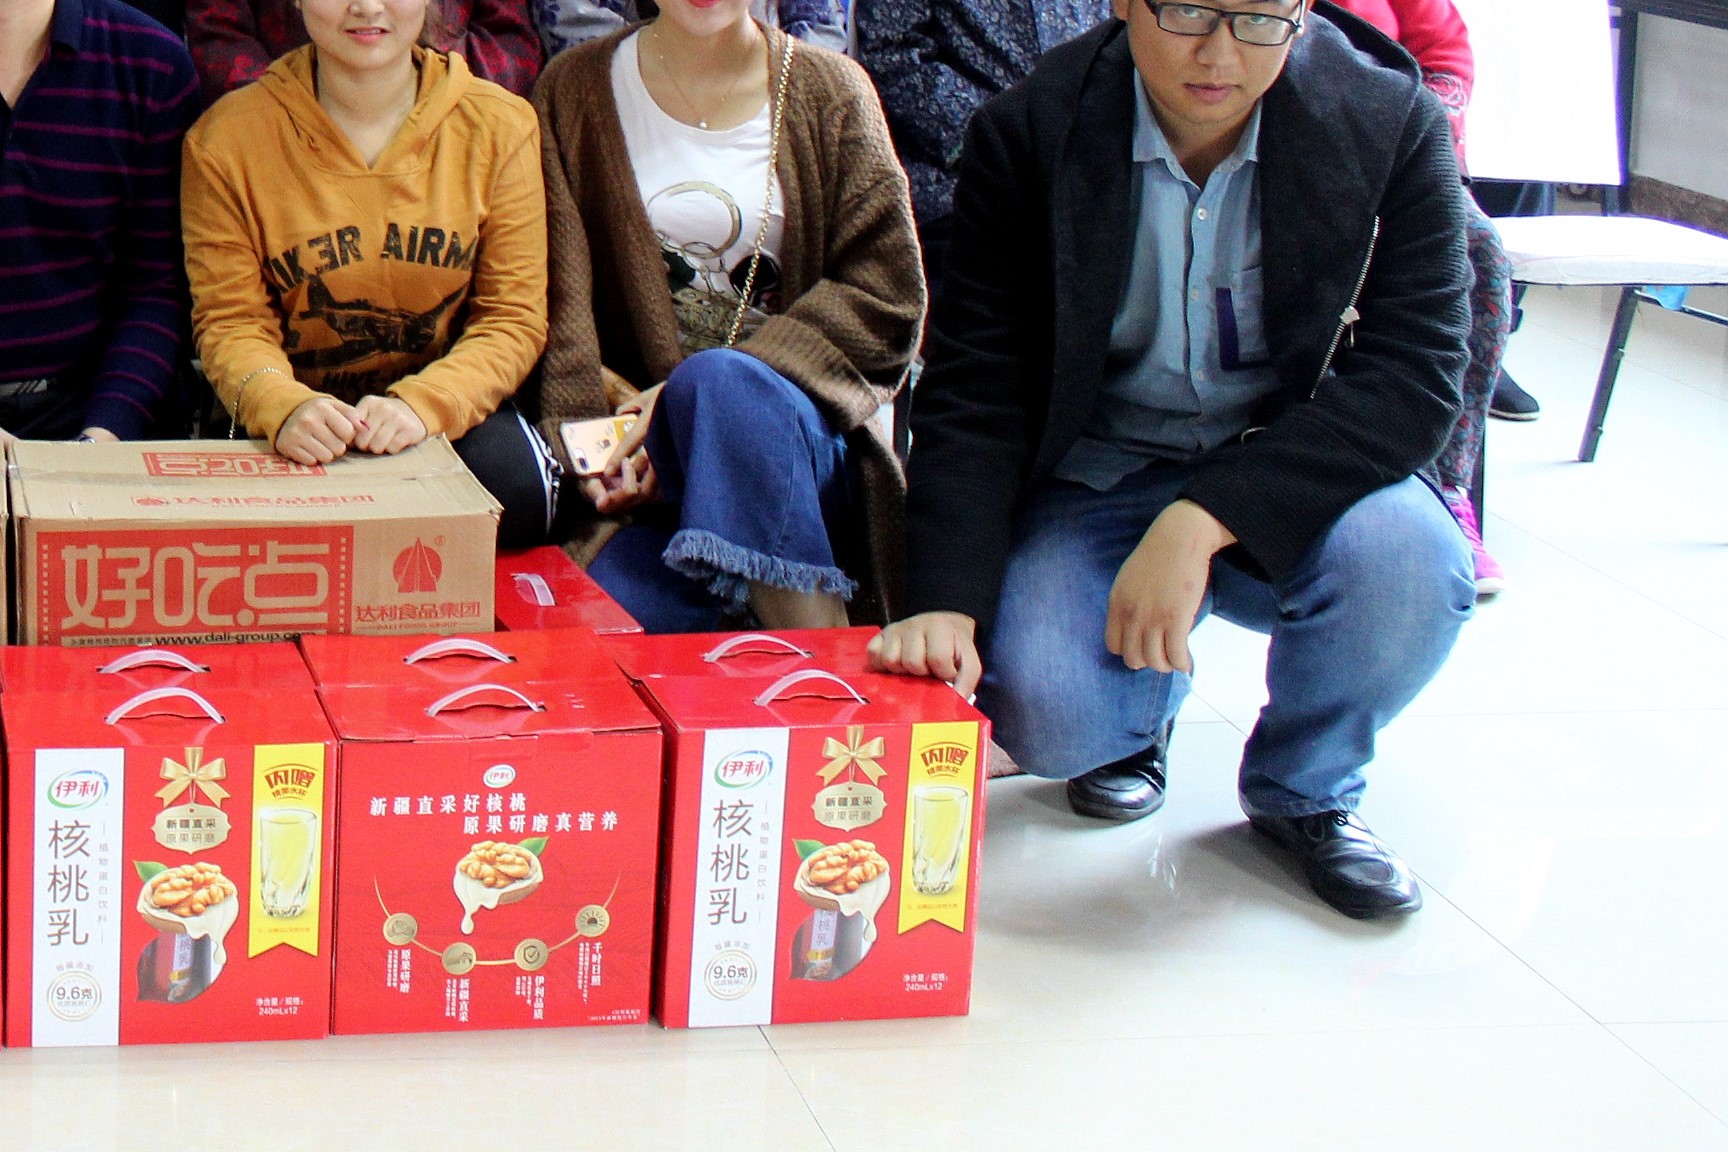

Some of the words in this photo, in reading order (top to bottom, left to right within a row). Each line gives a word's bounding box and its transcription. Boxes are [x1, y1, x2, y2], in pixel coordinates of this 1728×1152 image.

[61, 540, 330, 626] 好吃点
[356, 601, 480, 623] 达利食品集团
[722, 760, 764, 778] 伊利
[55, 780, 100, 798] 伊利
[369, 793, 527, 818] 新疆直采好核桃
[825, 796, 873, 808] 新疆直采
[165, 817, 217, 830] 新疆直采
[462, 809, 618, 836] 原果研磨真营养
[707, 799, 754, 926] 核桃乳
[47, 819, 91, 947] 核桃乳
[714, 965, 749, 979] 9.6克
[56, 986, 93, 1000] 9.6克
